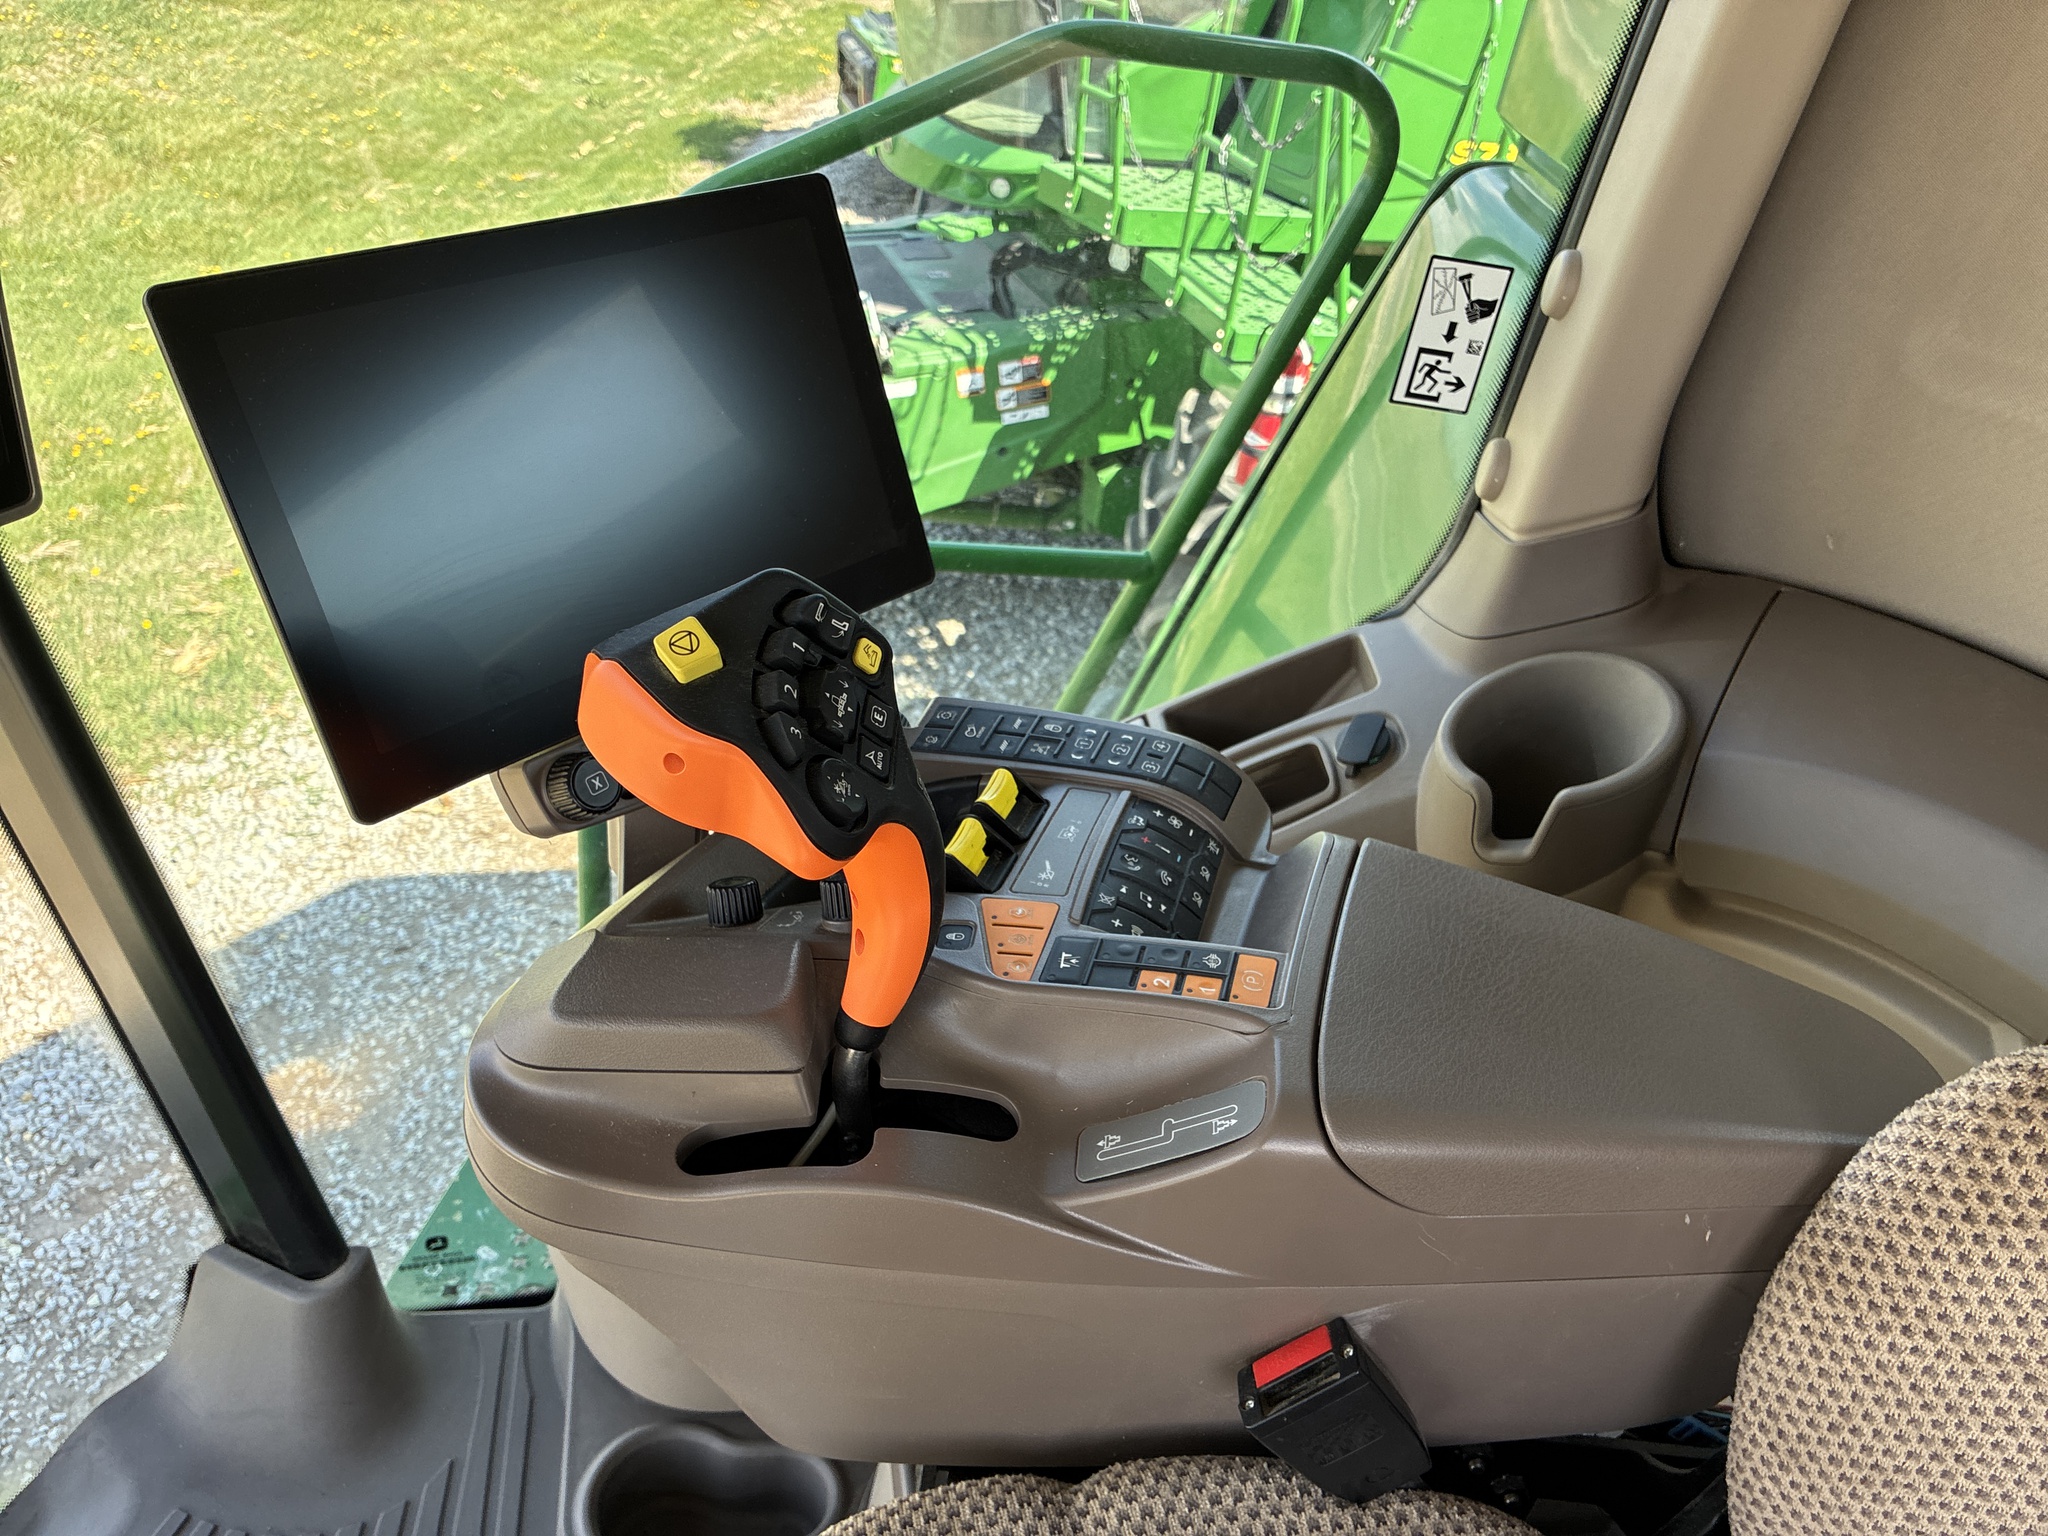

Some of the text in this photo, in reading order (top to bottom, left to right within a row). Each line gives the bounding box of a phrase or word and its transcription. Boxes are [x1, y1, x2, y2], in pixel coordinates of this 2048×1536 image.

[792, 641, 805, 653] 1
[784, 684, 798, 699] 2
[873, 711, 884, 722] E
[790, 726, 802, 739] 3
[876, 751, 884, 771] AUTO
[591, 776, 603, 790] X
[1153, 977, 1171, 988] 2
[1199, 986, 1216, 994] 1
